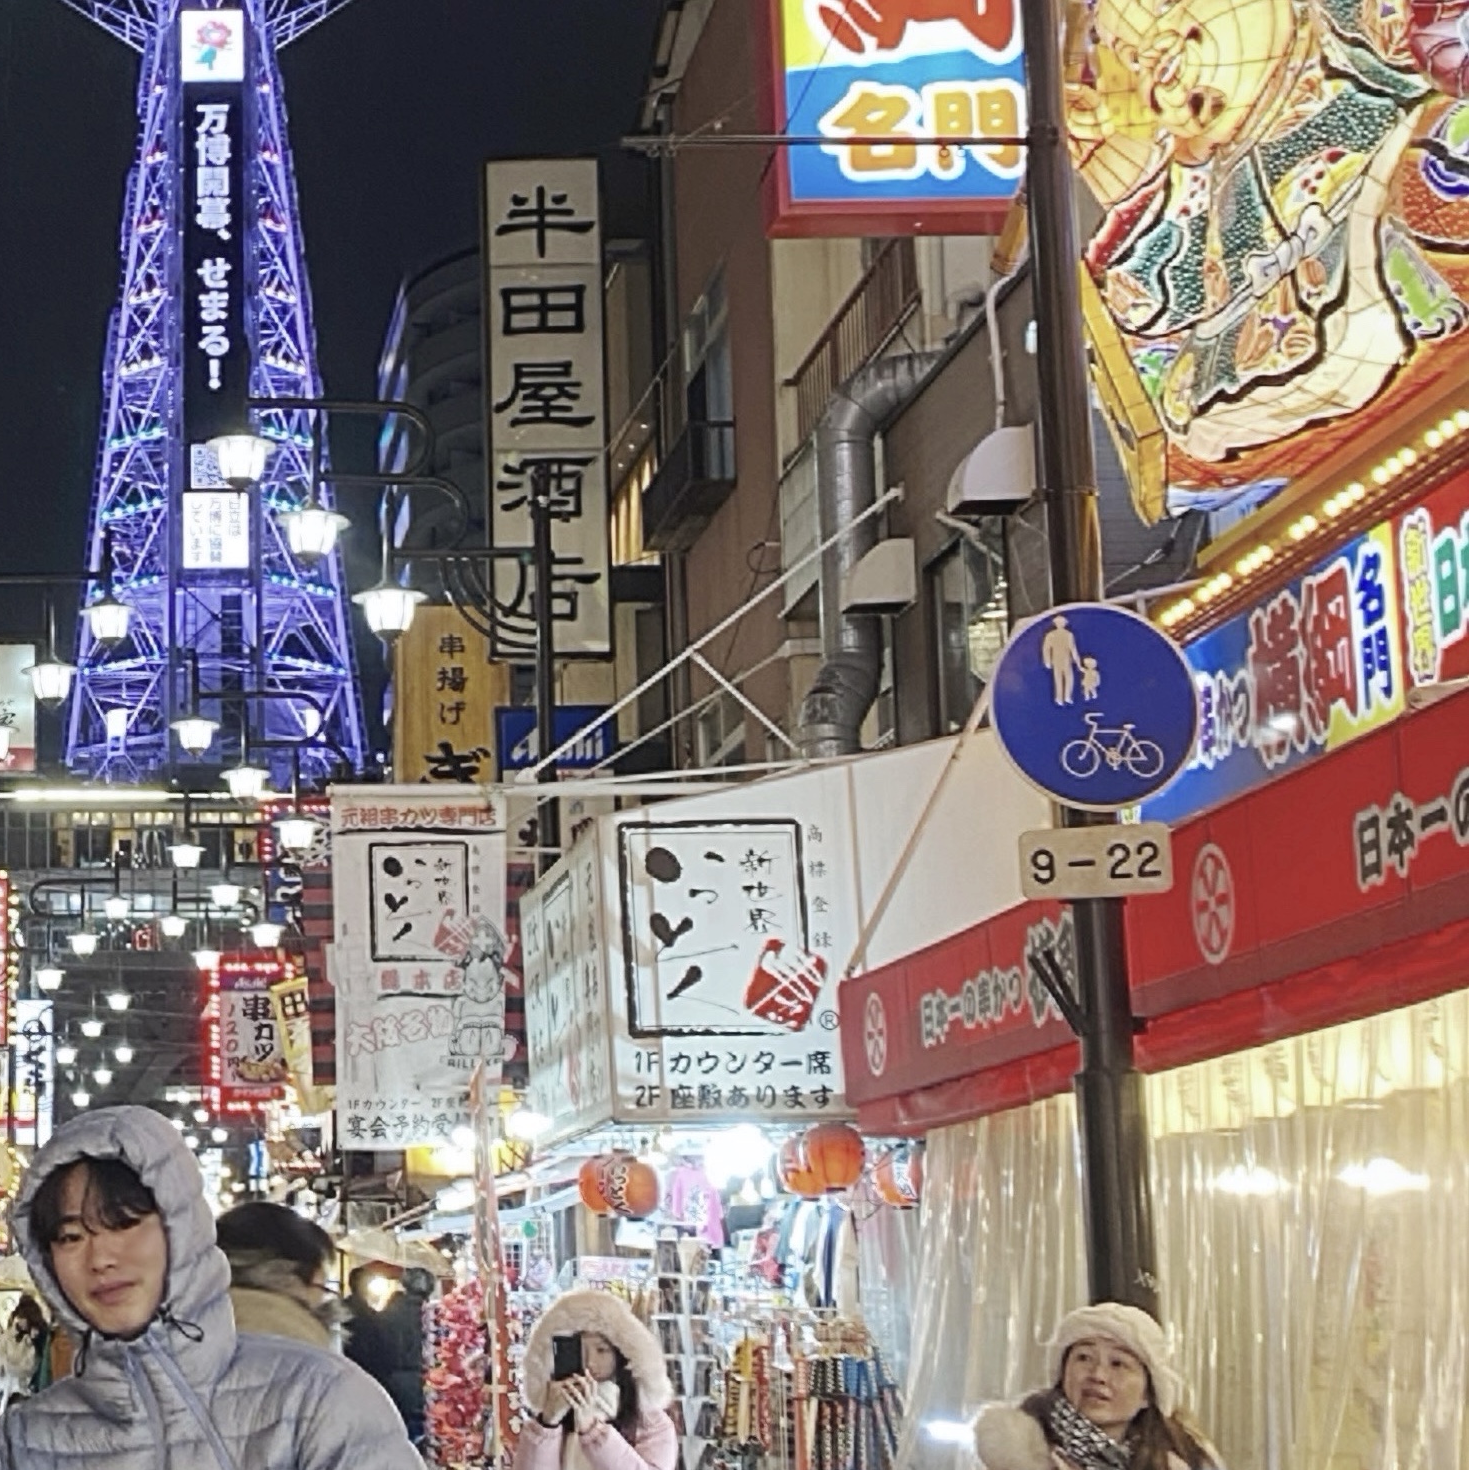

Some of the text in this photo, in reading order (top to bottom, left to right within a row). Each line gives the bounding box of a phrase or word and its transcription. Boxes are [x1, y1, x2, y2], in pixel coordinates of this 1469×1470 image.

[831, 84, 1021, 173] 名門
[494, 185, 601, 622] 半田屋酒店
[436, 633, 469, 726] 串揚げ
[512, 727, 604, 763] Ahi
[340, 806, 497, 828] 元祖串カツ専門店
[739, 849, 785, 934] 新世界
[807, 824, 833, 949] 商標登録
[242, 993, 275, 1063] 串カツ
[347, 1114, 472, 1140] 宴会予約受
